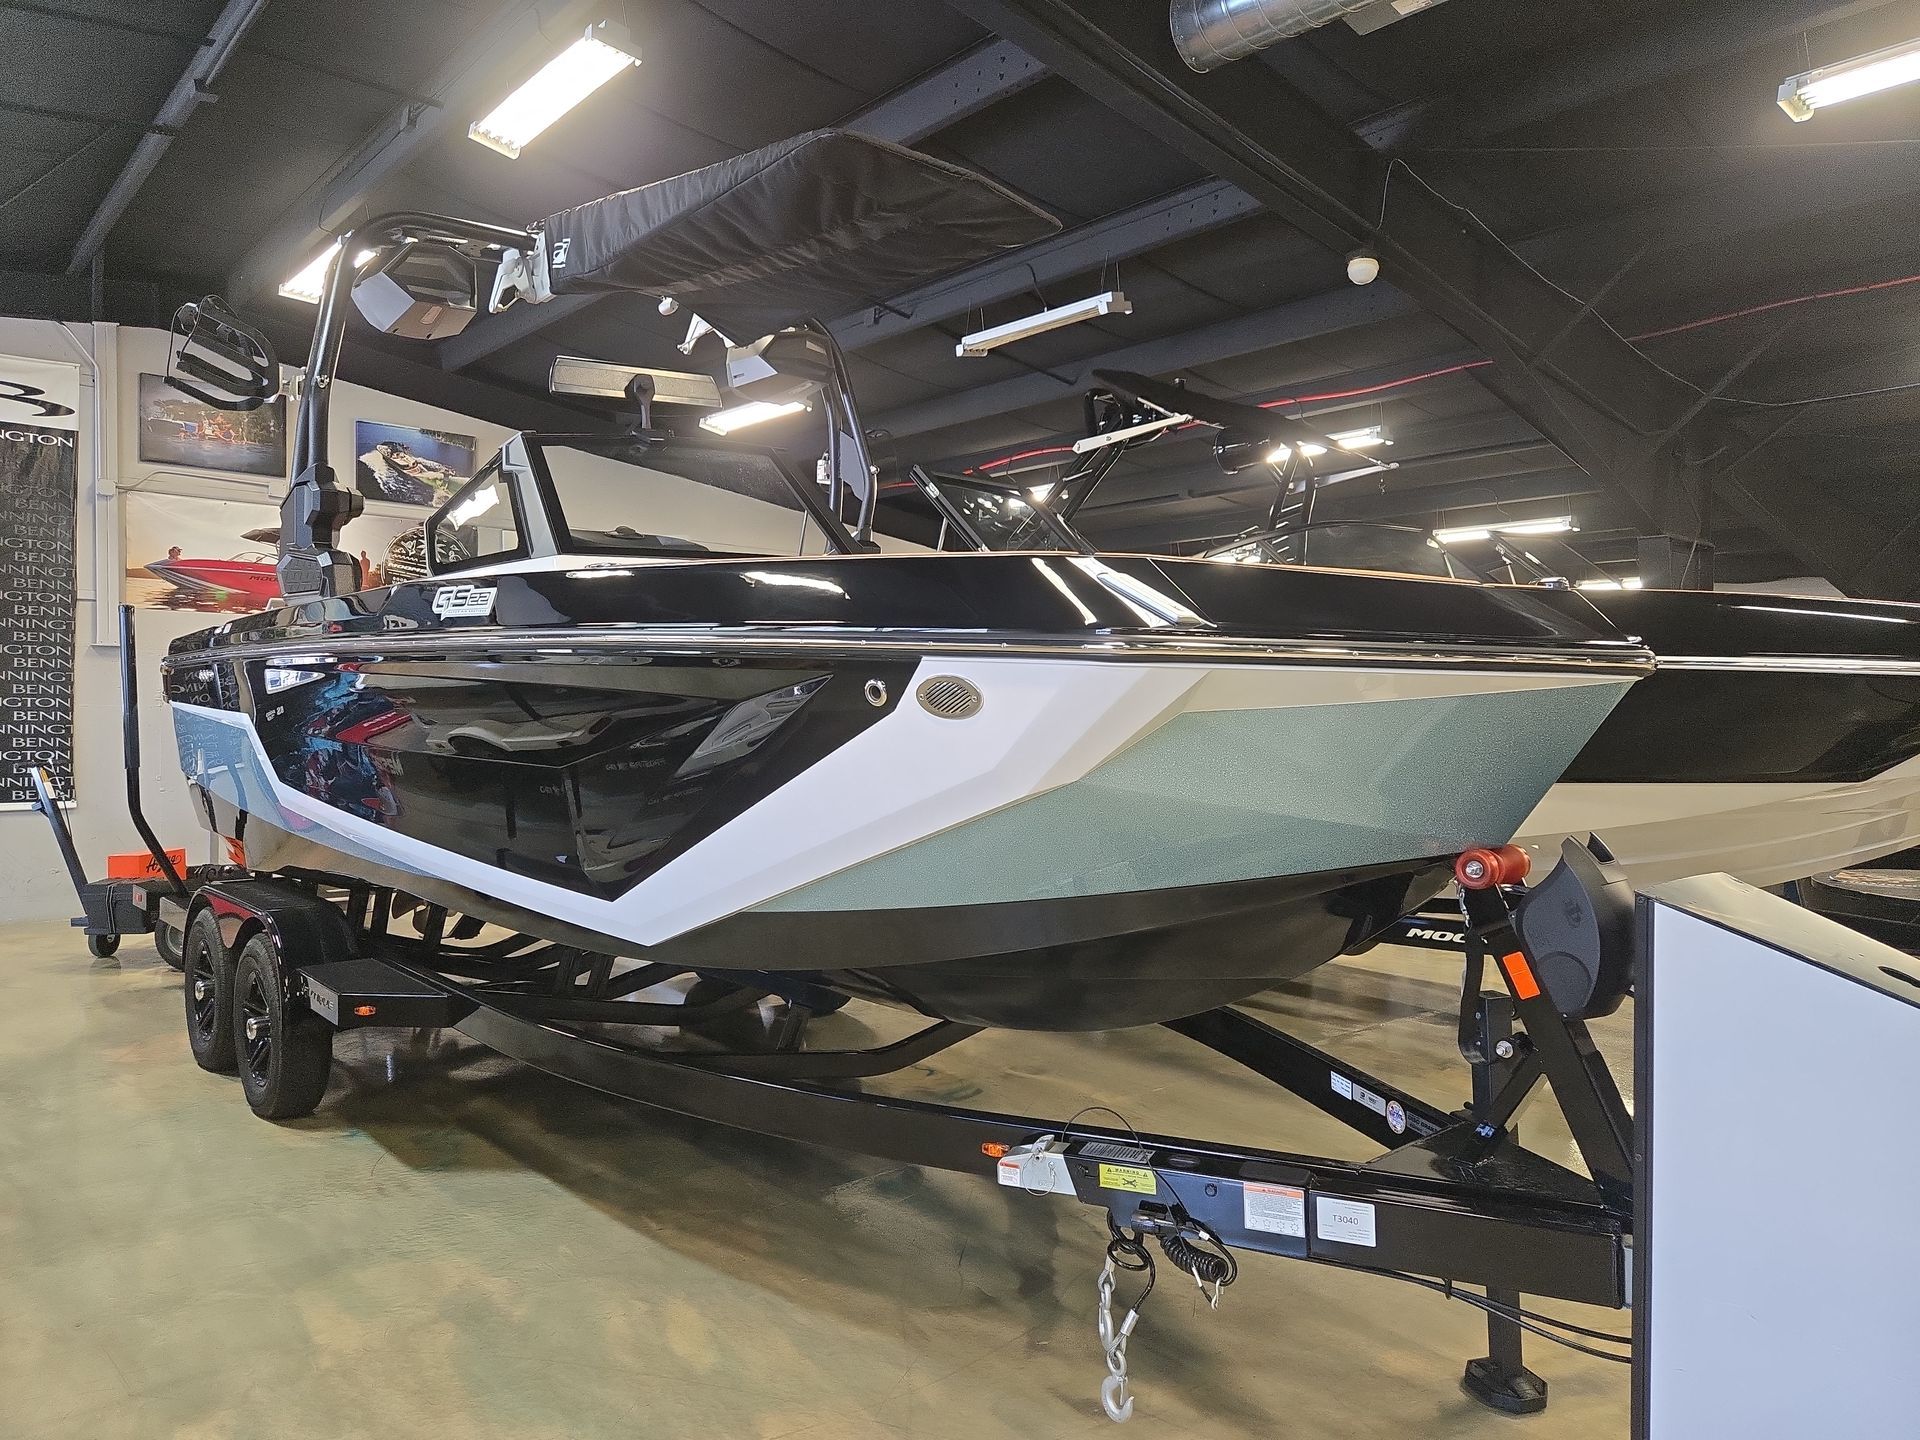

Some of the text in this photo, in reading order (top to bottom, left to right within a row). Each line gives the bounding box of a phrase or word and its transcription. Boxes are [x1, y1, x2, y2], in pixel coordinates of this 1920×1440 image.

[0, 537, 72, 551] GTON
[14, 551, 73, 565] BENN
[13, 577, 72, 590] BENN
[0, 590, 72, 604] GTON
[14, 604, 73, 617] BENN
[13, 631, 72, 643] BENN
[0, 644, 71, 656] GTON
[13, 657, 72, 669] BENN
[12, 683, 71, 695] BENN
[0, 696, 71, 708] GTON
[13, 710, 72, 721] BENN
[12, 737, 71, 748] BENN
[0, 750, 71, 761] GTON
[1332, 1214, 1360, 1226] T3040
